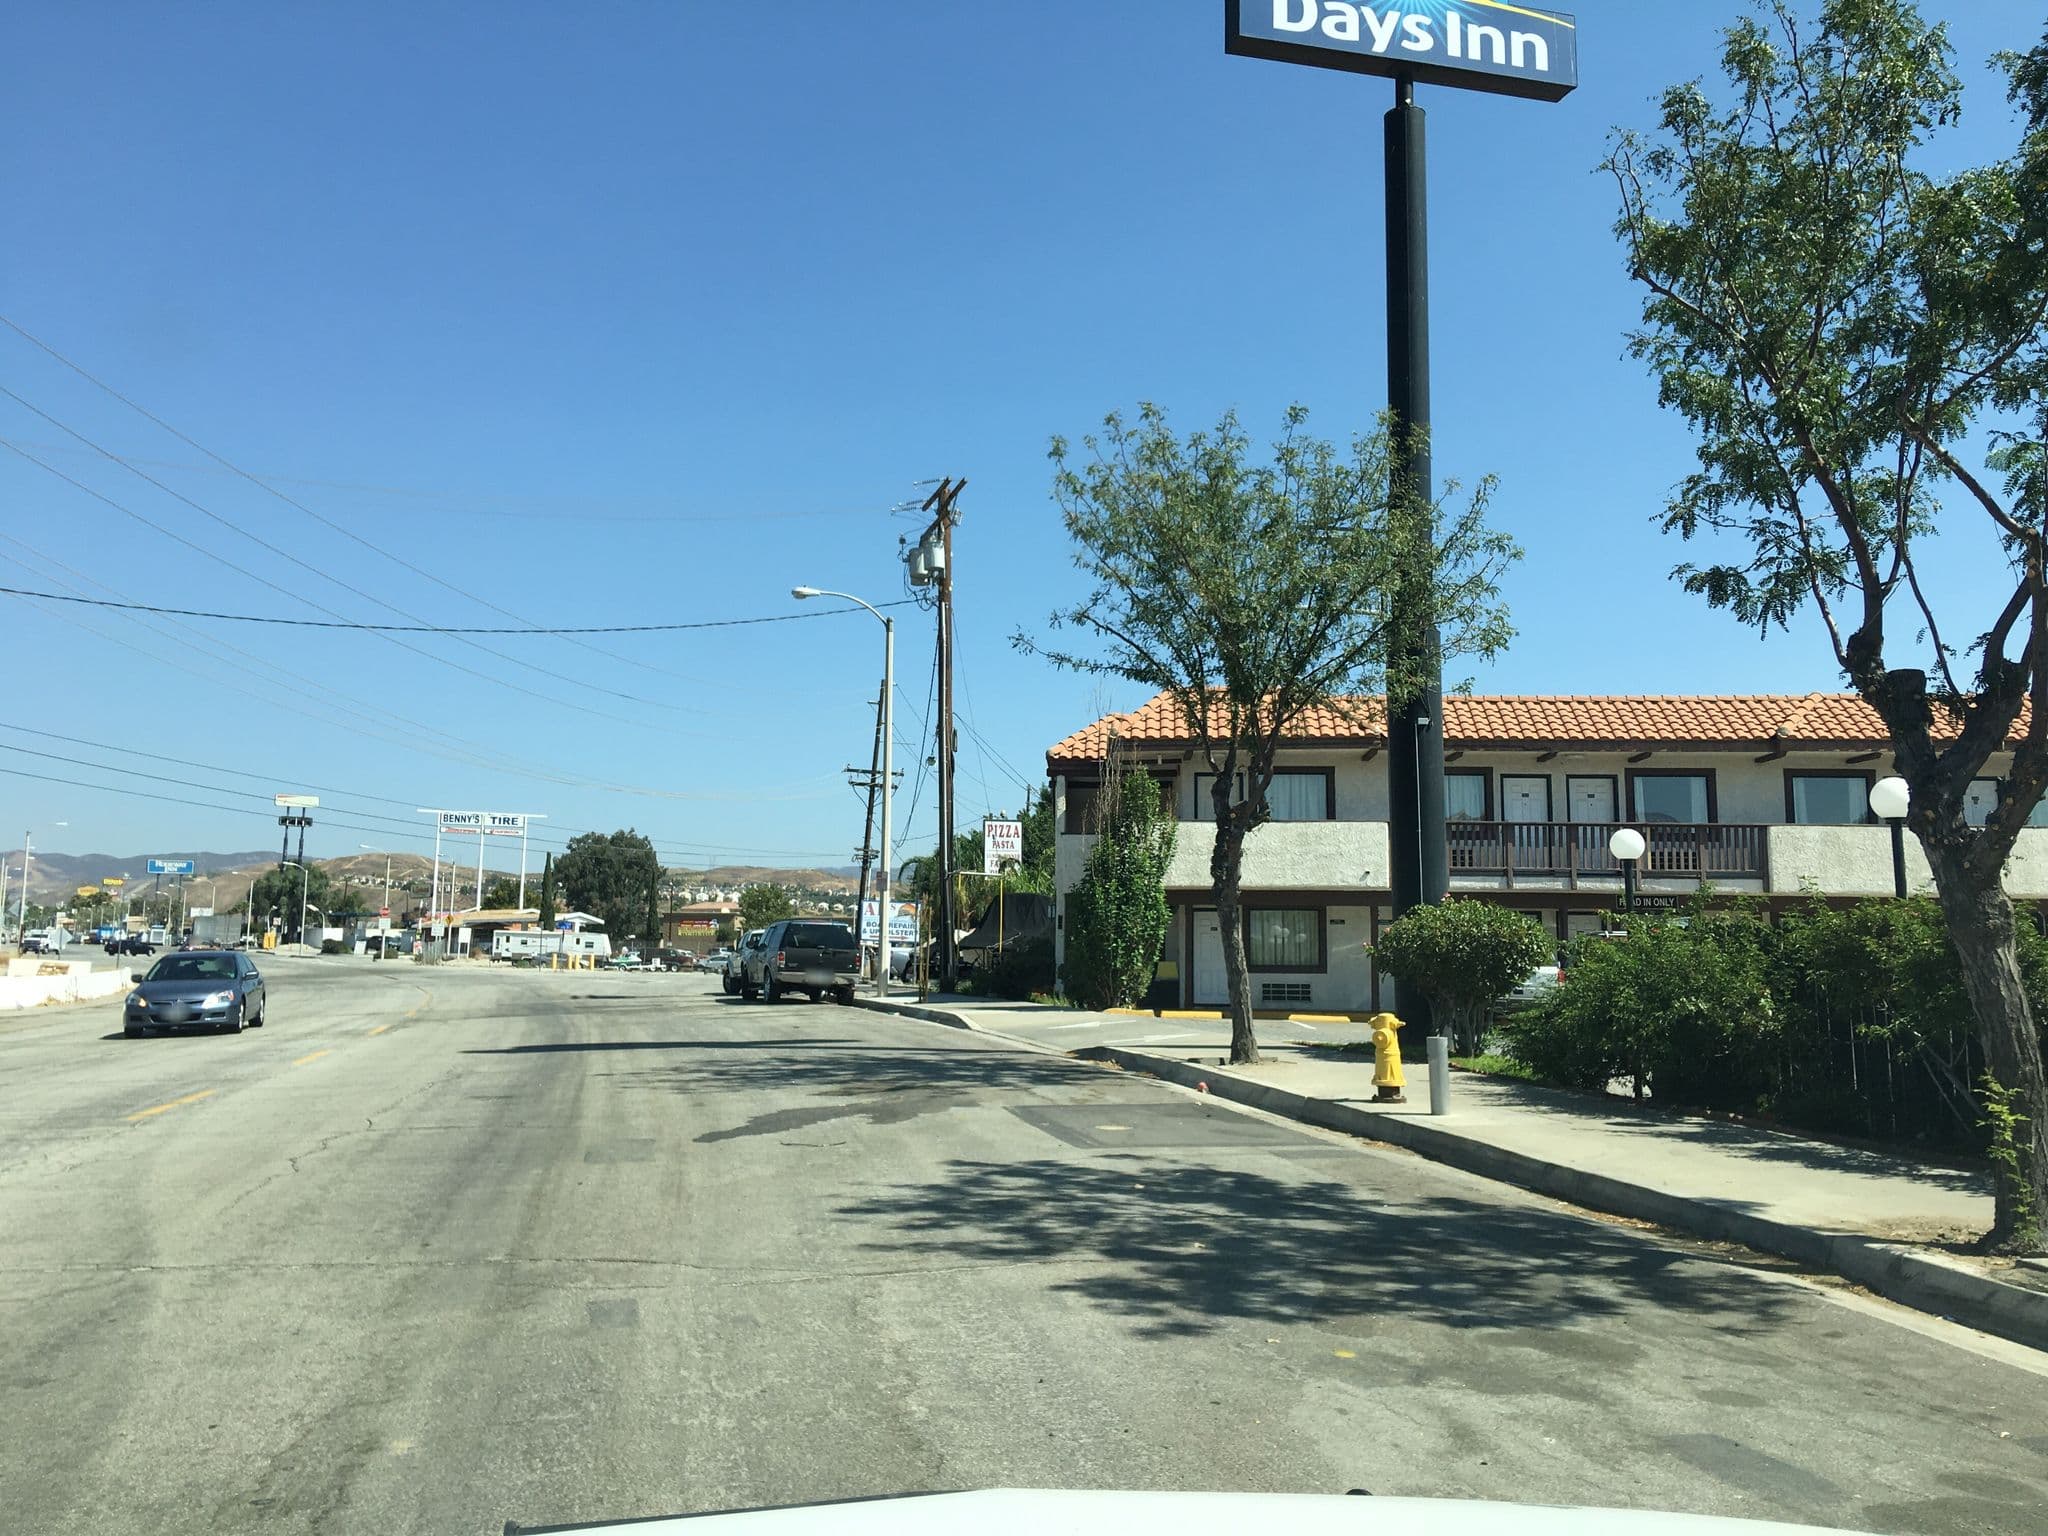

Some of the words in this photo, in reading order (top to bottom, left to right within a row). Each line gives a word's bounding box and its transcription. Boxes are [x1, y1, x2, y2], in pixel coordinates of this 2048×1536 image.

[1272, 0, 1434, 53] Days
[1447, 10, 1549, 71] Inn
[443, 814, 480, 824] BENNY'S
[490, 816, 519, 826] TIRE
[987, 824, 1020, 838] PIZZA
[992, 840, 1015, 849] PASTA
[1619, 897, 1642, 907] HD
[1643, 897, 1652, 907] IN
[1653, 897, 1675, 907] ONLY
